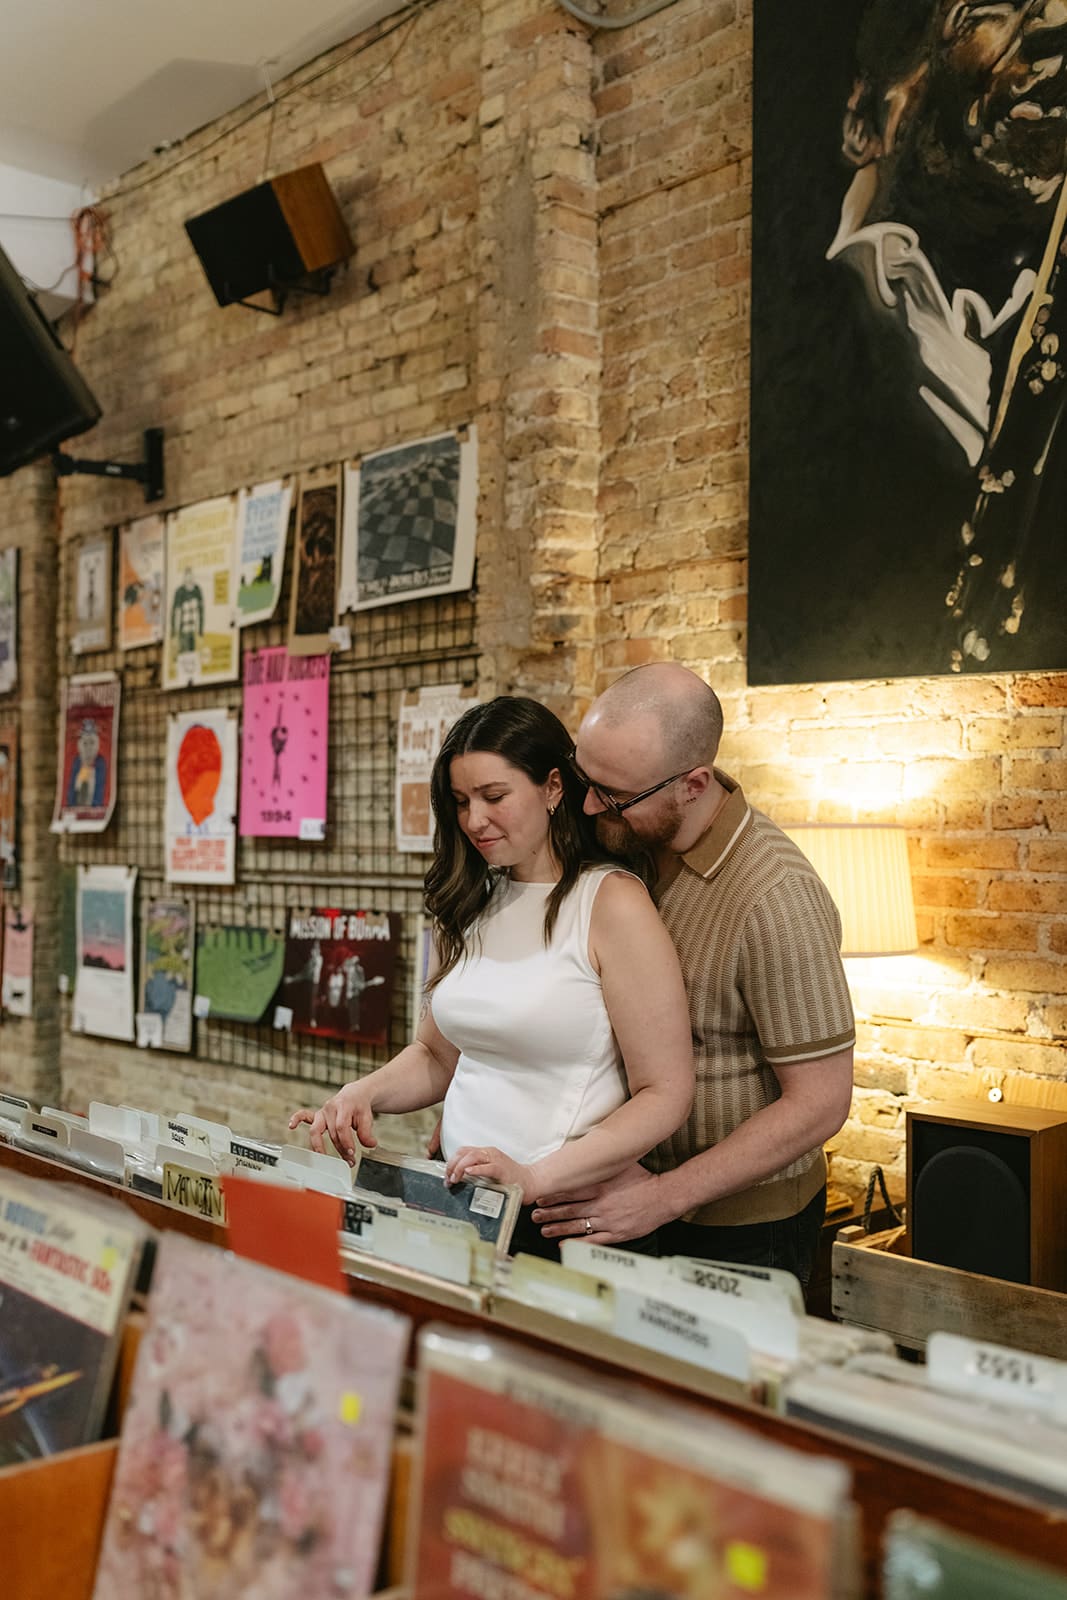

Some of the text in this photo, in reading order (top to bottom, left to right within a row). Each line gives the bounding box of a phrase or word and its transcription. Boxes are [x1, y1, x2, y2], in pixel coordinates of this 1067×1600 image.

[290, 916, 331, 940] MISSION
[333, 915, 348, 940] OF
[693, 1268, 742, 1297] 2058
[976, 1349, 1036, 1385] 1552
